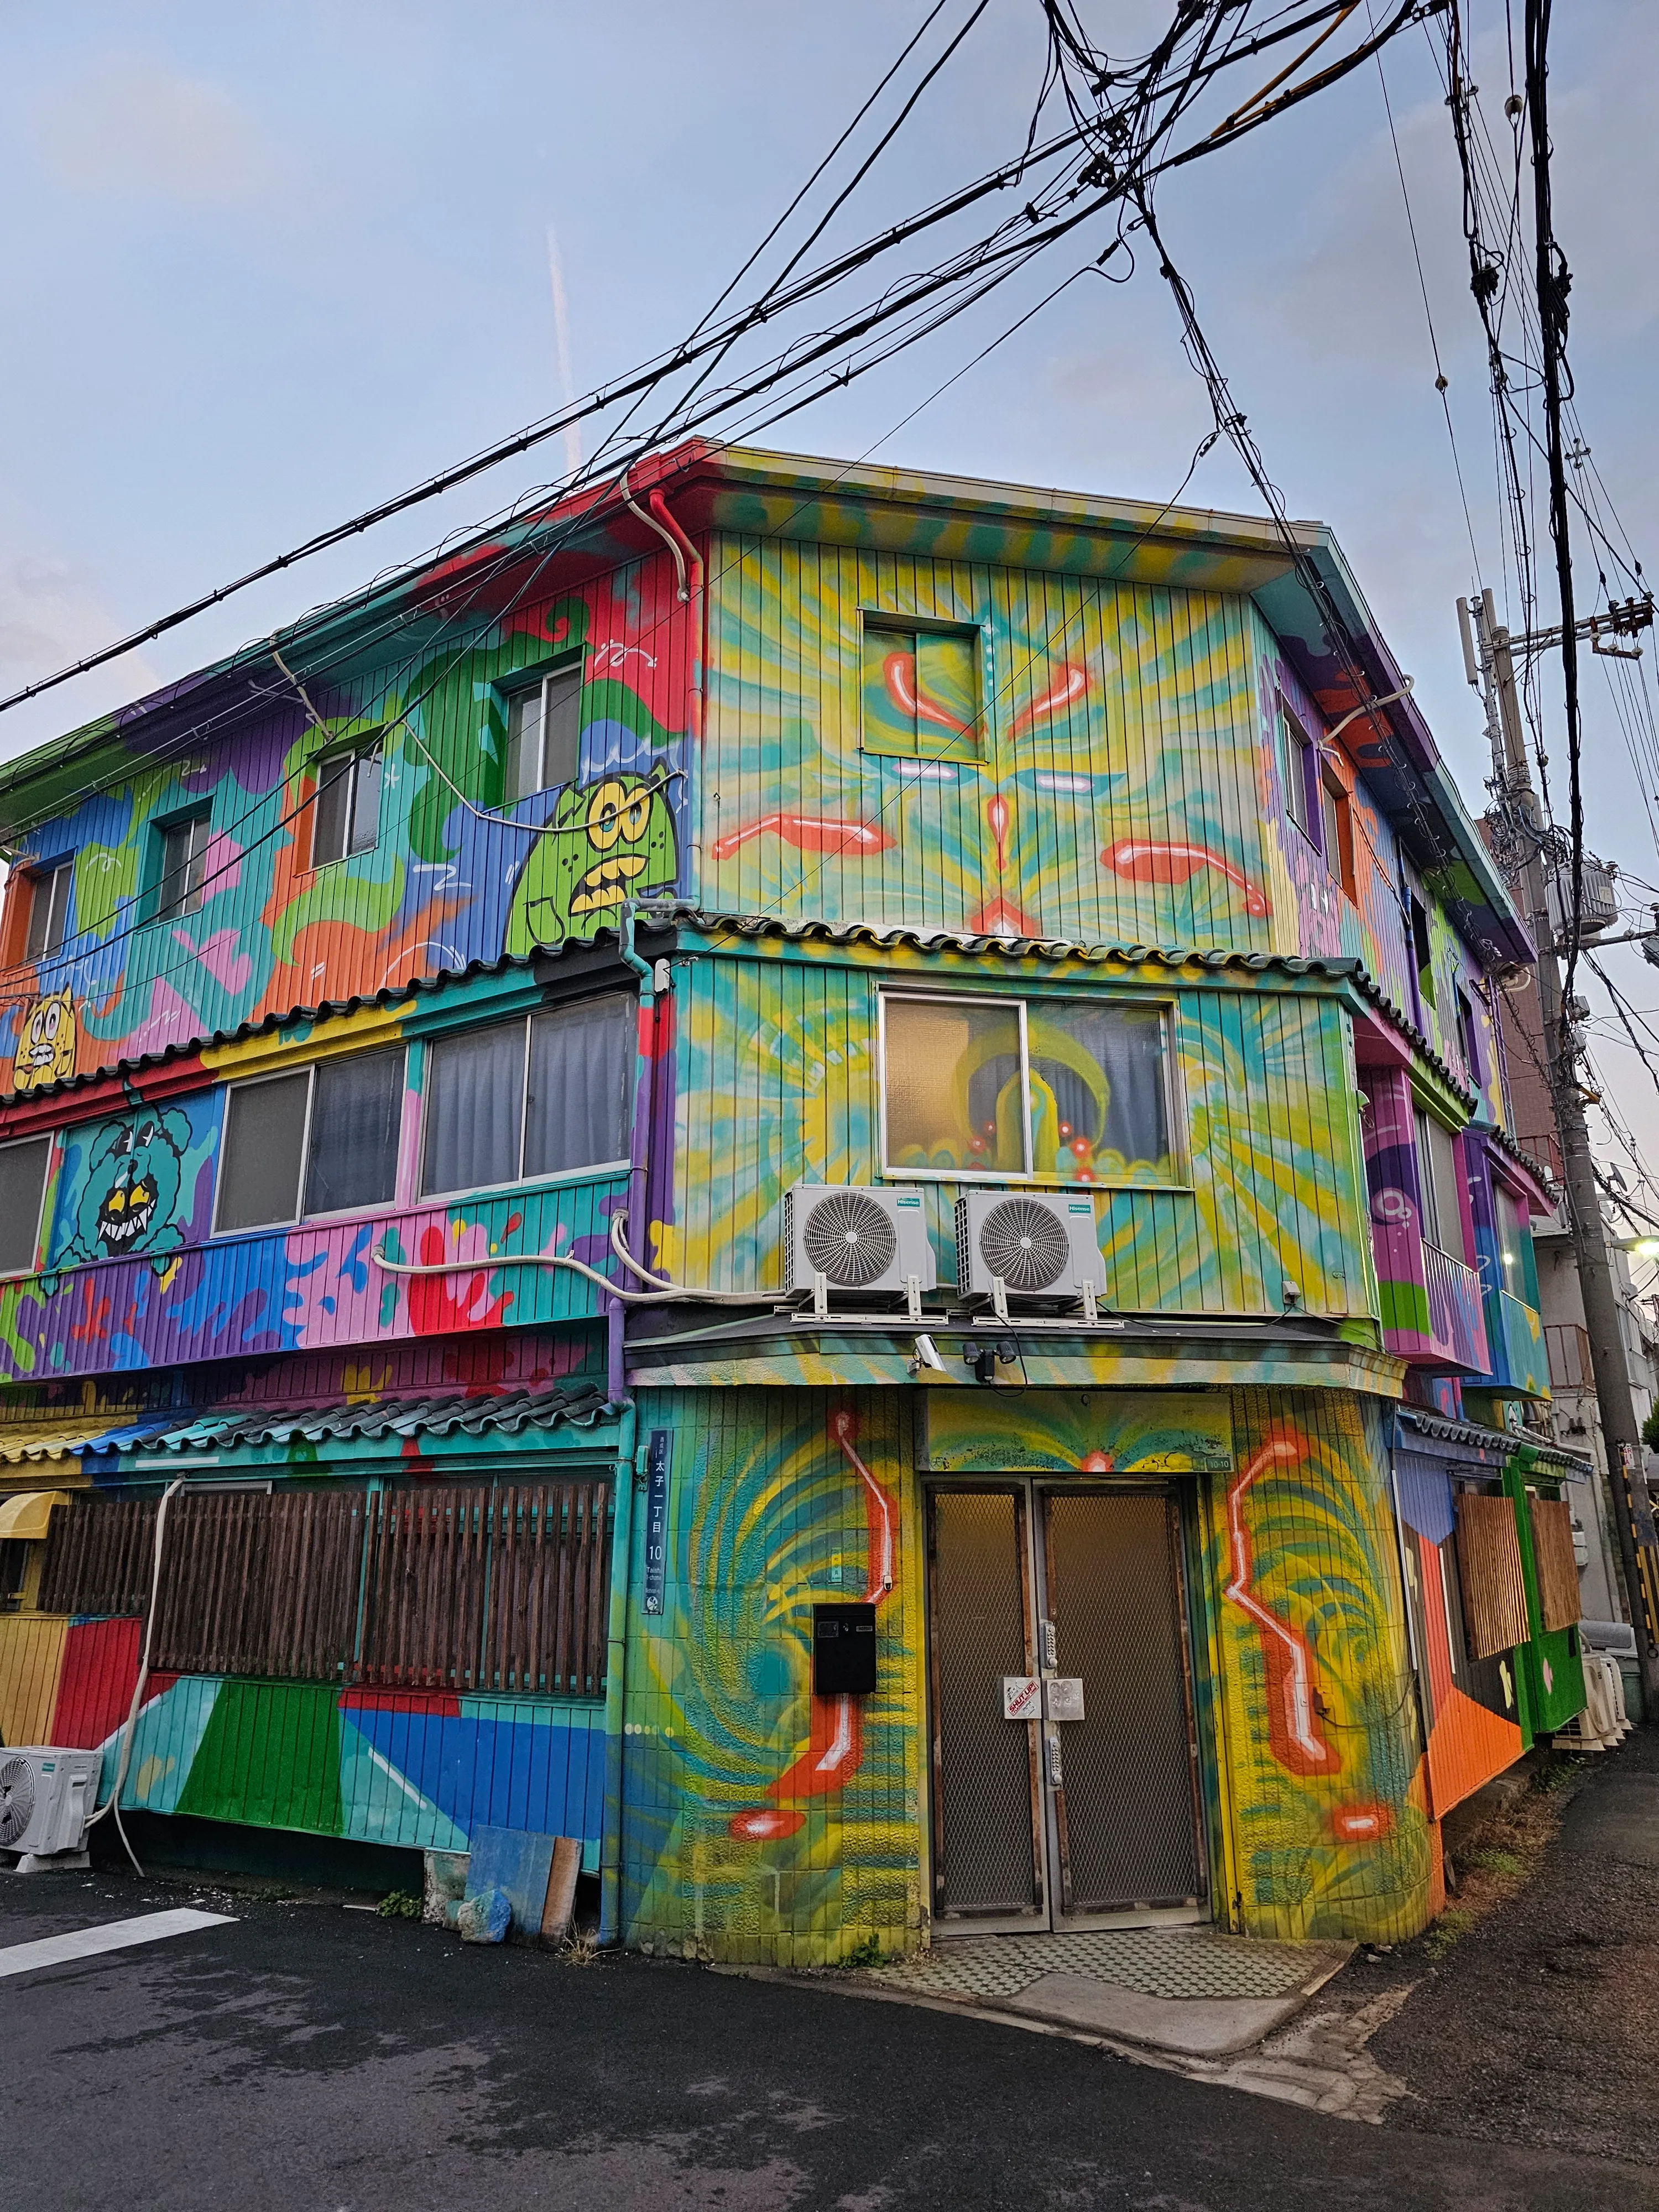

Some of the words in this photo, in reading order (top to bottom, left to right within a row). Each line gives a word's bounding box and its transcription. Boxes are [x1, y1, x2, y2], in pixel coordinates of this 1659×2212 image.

[653, 1460, 665, 1533] 太子一丁目
[649, 1546, 662, 1560] 10
[1009, 1693, 1024, 1712] SHUT
[1024, 1682, 1036, 1695] UP!
